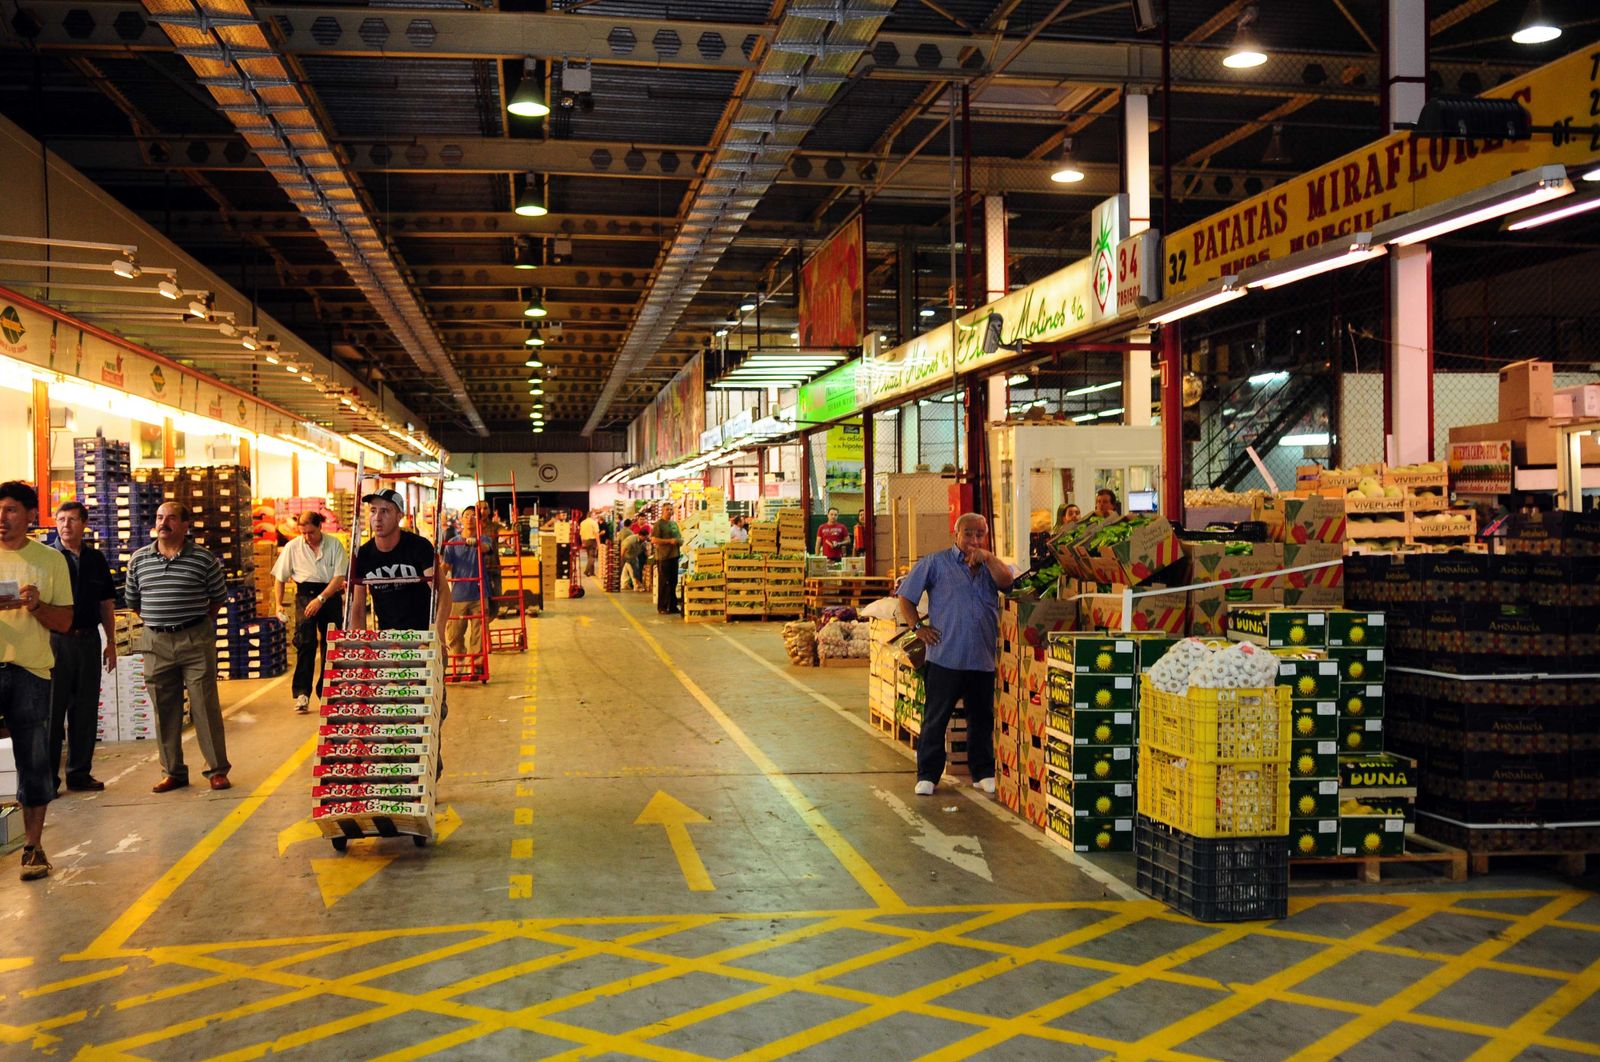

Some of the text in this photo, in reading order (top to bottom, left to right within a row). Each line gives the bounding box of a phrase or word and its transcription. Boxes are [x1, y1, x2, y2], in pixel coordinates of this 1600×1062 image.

[1193, 86, 1532, 266] PATATAS MIRAFLO
[1168, 250, 1188, 285] 32
[1011, 288, 1066, 342] Molinos
[1328, 477, 1363, 486] VIVEPL
[1394, 475, 1444, 484] VIVEPLANT
[1354, 500, 1404, 510] VIVEPLANT
[1421, 524, 1472, 533] VIVEPLANT
[1236, 617, 1264, 634] DUNA
[1350, 772, 1408, 785] DUNA
